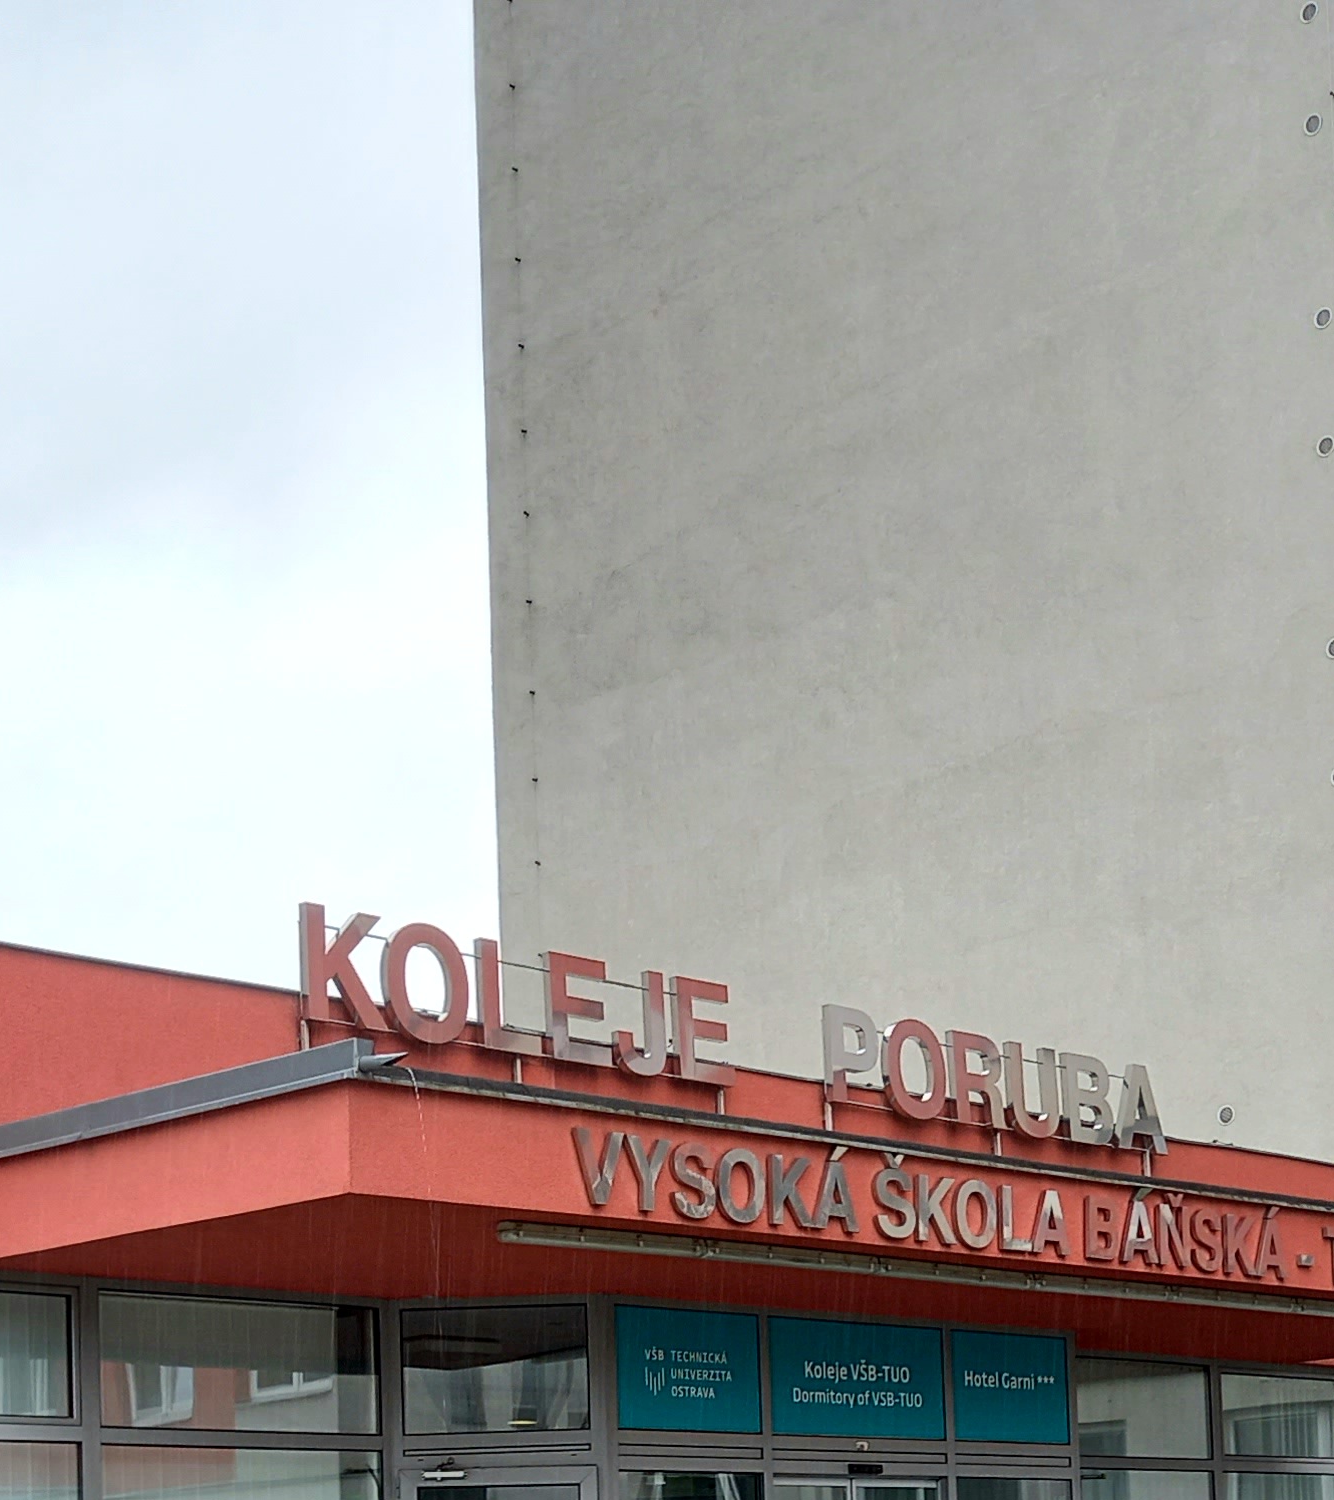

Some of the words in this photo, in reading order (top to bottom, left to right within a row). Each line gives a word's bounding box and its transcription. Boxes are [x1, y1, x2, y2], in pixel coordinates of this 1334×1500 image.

[299, 901, 736, 1087] KOLEJE
[821, 1003, 1168, 1155] PORUBA
[571, 1126, 859, 1233] VYSOKÁ
[871, 1152, 1070, 1256] ŠKOLA
[1083, 1188, 1287, 1282] BÁŇSKÁ
[644, 1346, 665, 1361] VŠB
[670, 1350, 728, 1365] TECHNICKÁ
[670, 1367, 732, 1382] UNIVERZITA
[804, 1360, 848, 1384] Koleje
[850, 1359, 910, 1383] VŠB-TUO
[964, 1370, 999, 1389] Hotel
[1001, 1372, 1035, 1390] Garni
[670, 1385, 716, 1399] OSTRAVA
[793, 1387, 855, 1408] Dormitory
[857, 1390, 871, 1406] of
[871, 1391, 923, 1408] VSB-TUO
